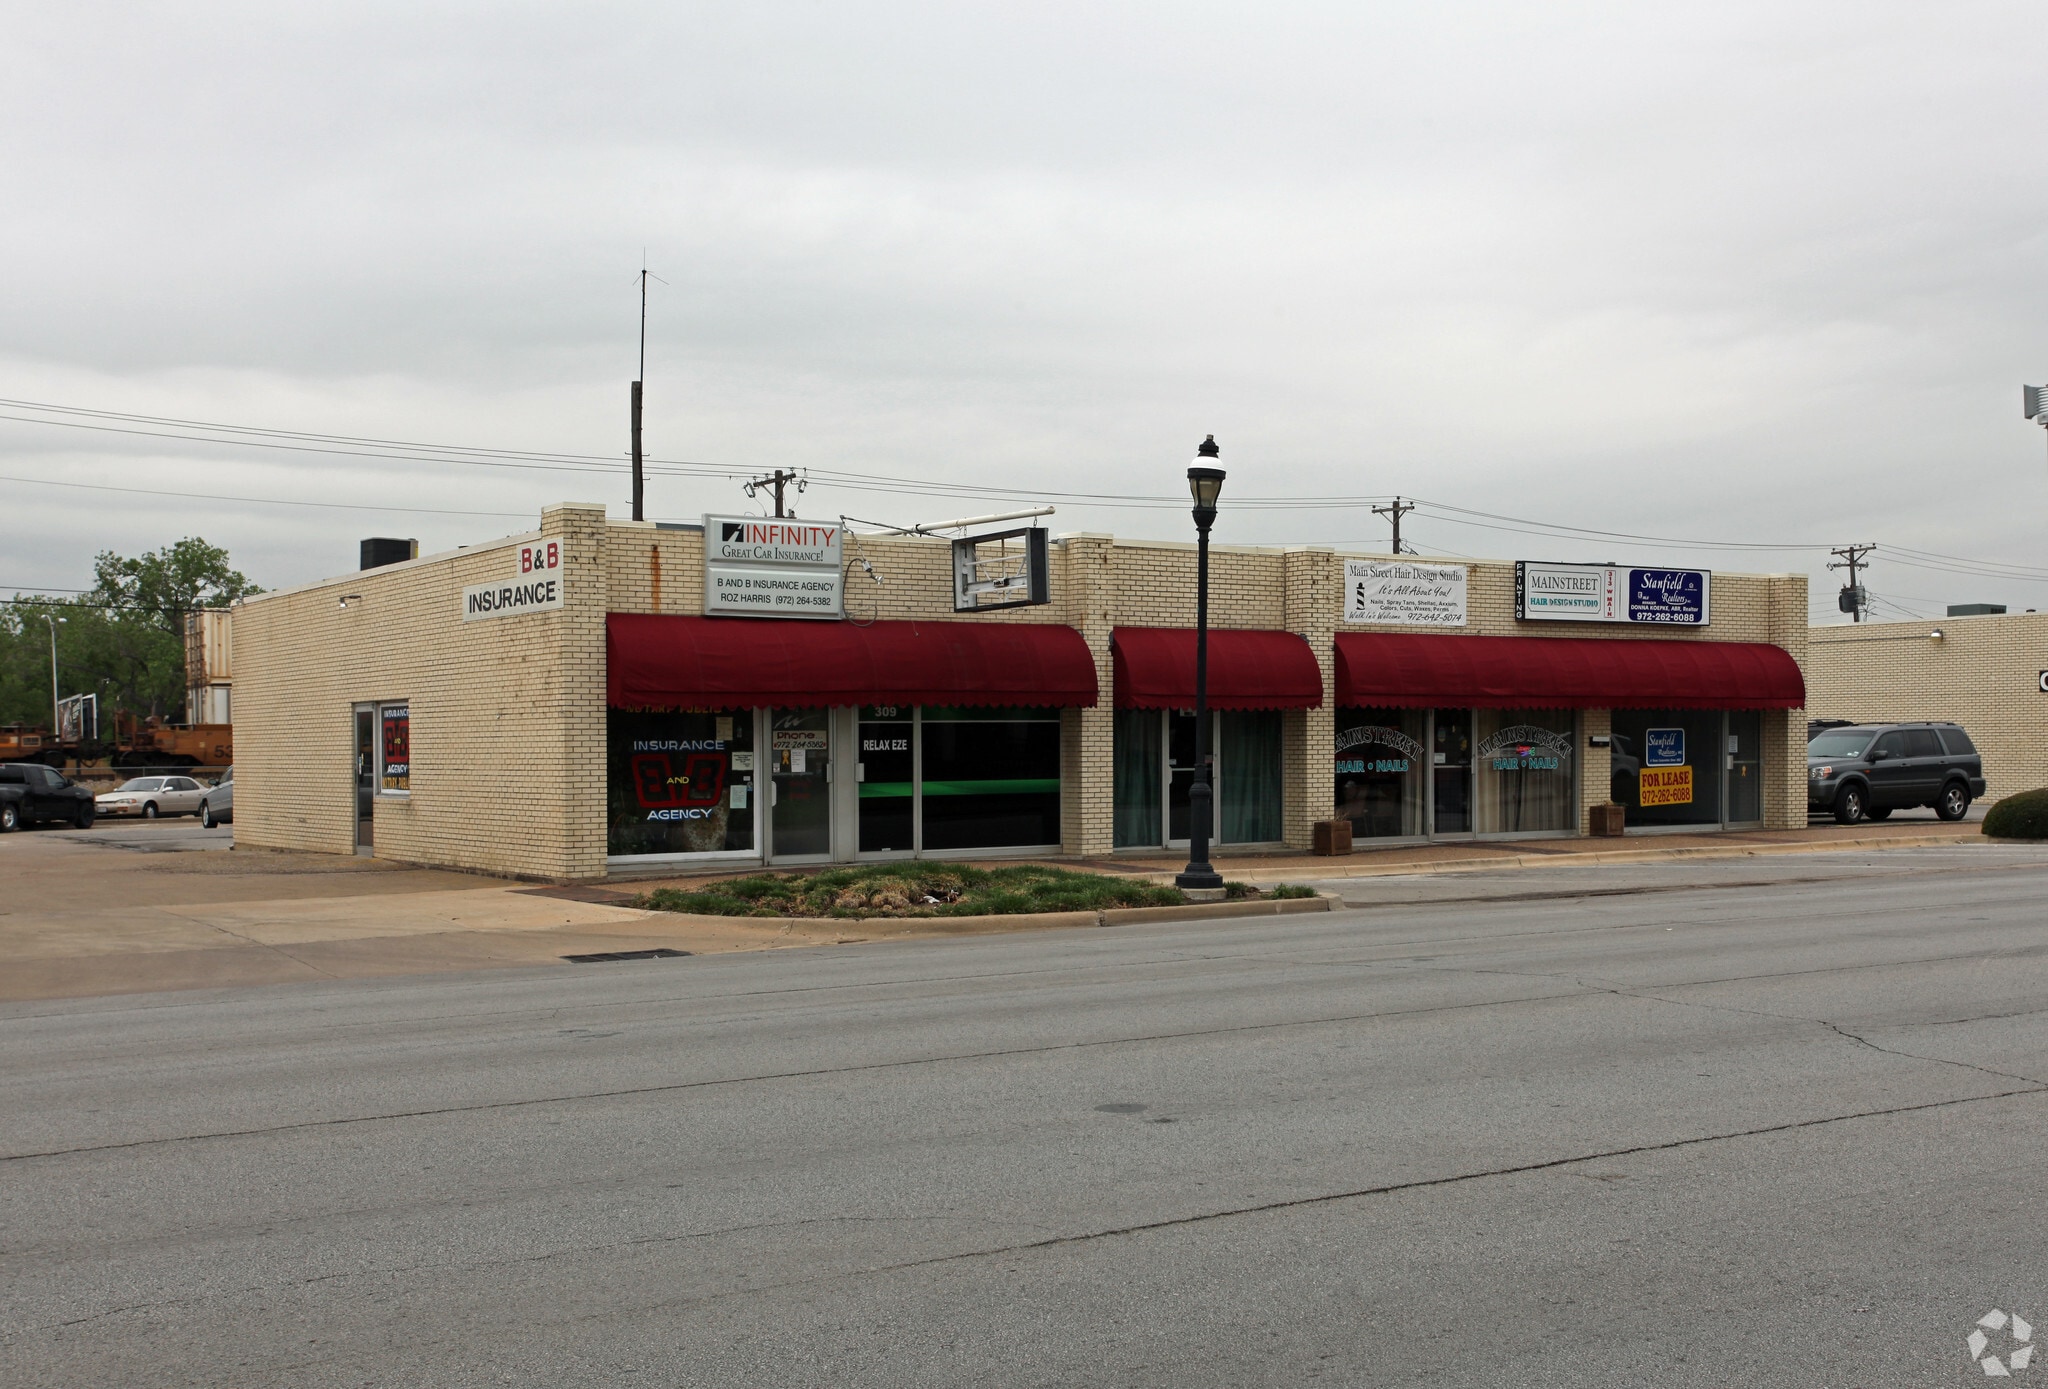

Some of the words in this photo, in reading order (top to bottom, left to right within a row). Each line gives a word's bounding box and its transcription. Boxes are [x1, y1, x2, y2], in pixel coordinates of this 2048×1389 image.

[746, 524, 835, 547] INFINITY
[1350, 565, 1368, 577] Main
[1370, 566, 1392, 579] Street
[1394, 568, 1411, 579] Hair
[1413, 569, 1437, 583] Design
[1439, 569, 1463, 582] Studio
[717, 578, 723, 587] B
[725, 578, 743, 588] AND
[745, 579, 751, 588] B
[753, 579, 799, 590] INSURANCE
[801, 582, 834, 592] AGENCY
[1531, 575, 1598, 591] MAINSTREET
[1641, 572, 1687, 594] Stanfield
[469, 580, 556, 614] INSURANCE
[1379, 584, 1392, 595] It's
[1394, 585, 1409, 596] All
[1409, 585, 1432, 596] About
[1434, 586, 1452, 597] You!
[720, 593, 738, 603] ROZ
[740, 594, 771, 604] HARRIS
[775, 595, 794, 606] (972)
[796, 596, 831, 606] 264-5382
[1530, 597, 1548, 606] HAIR
[1549, 598, 1573, 607] DESIGN
[1574, 599, 1599, 608] STUDIO
[1407, 612, 1462, 622] 972-642-5074
[1637, 612, 1695, 621] 972-262-6088
[875, 706, 897, 717] 309
[777, 732, 815, 740] Phone
[1478, 725, 1573, 760] MAINSTREET
[634, 740, 725, 750] INSURANCE
[863, 739, 890, 751] RELAX
[892, 739, 908, 751] EZE
[1335, 725, 1425, 761] AINSTREET
[1336, 760, 1365, 774] HAIR
[1376, 759, 1409, 773] NAILS
[1492, 757, 1519, 770] HAIR
[1528, 757, 1559, 770] NAILS
[666, 776, 690, 785] AND
[1642, 773, 1660, 788] FOR
[1661, 771, 1690, 786] LEASE
[1641, 787, 1690, 804] 972-262-6088
[647, 809, 713, 821] AGENCY
